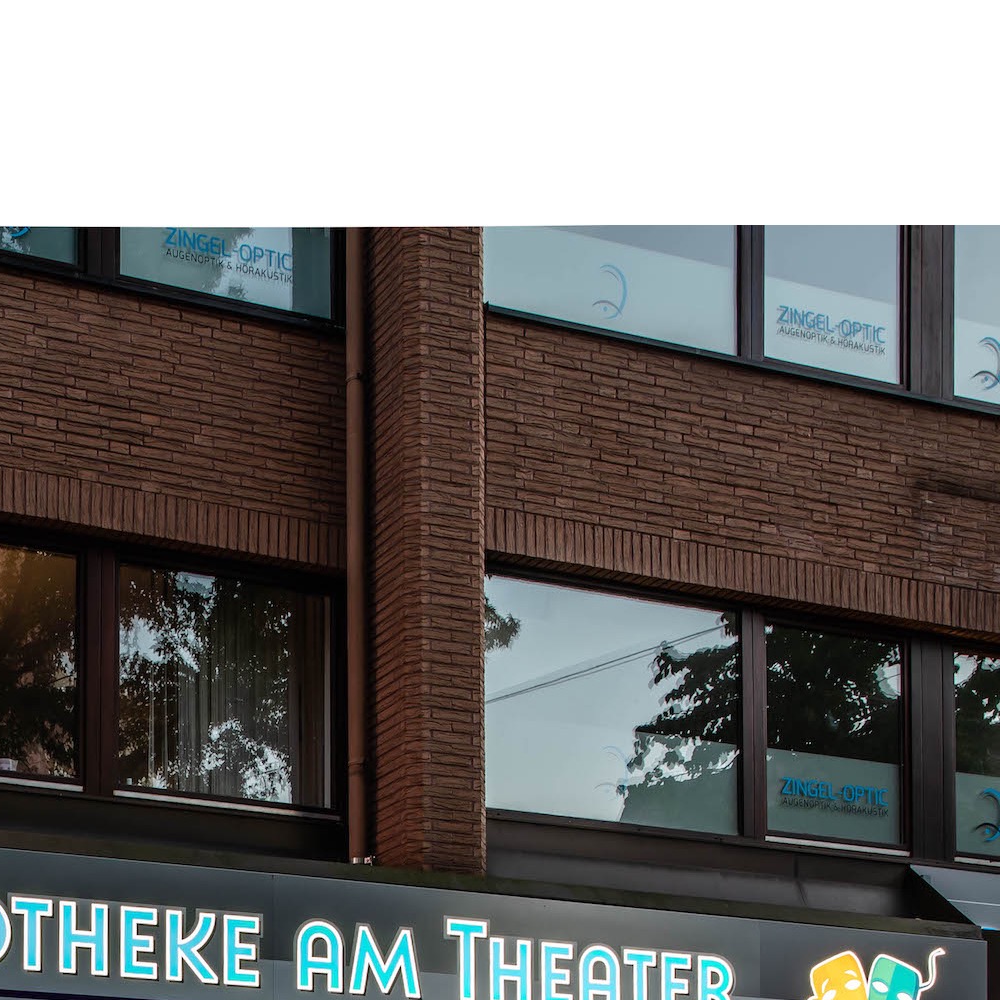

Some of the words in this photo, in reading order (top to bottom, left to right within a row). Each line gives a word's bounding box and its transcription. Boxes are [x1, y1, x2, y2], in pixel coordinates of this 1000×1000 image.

[166, 248, 224, 269] AUGENOPTIK
[226, 261, 233, 270] &
[779, 325, 828, 343] AUGENOPTIK
[782, 797, 832, 810] AUGENOPTIK
